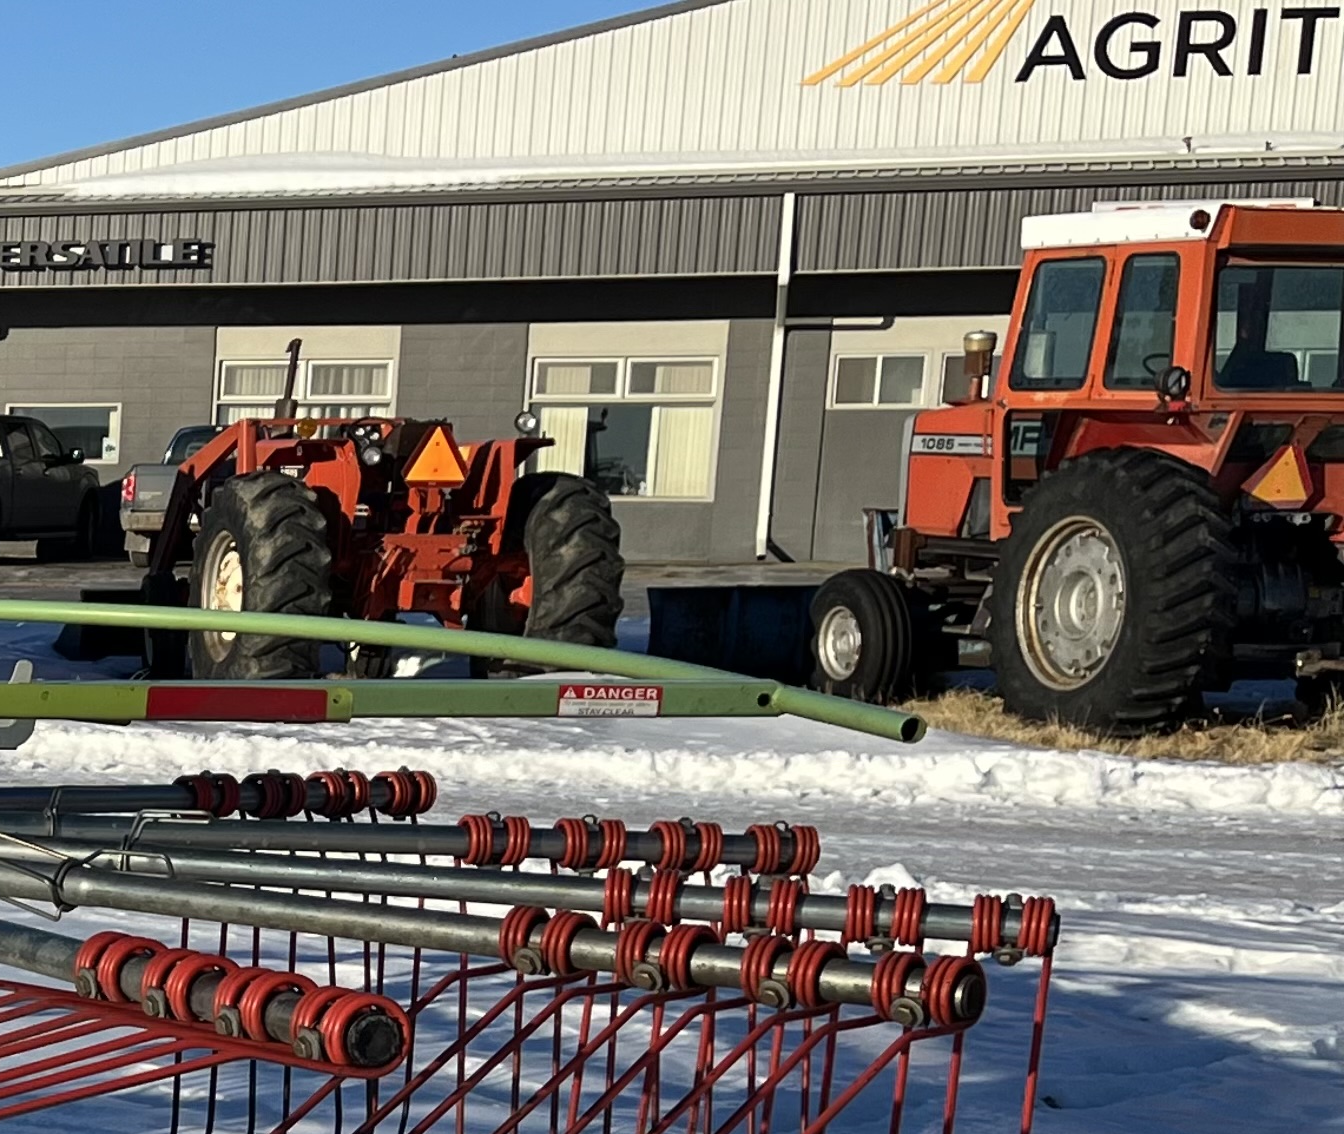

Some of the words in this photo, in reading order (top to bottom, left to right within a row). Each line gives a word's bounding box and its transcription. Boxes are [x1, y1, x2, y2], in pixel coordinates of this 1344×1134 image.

[1014, 7, 1340, 83] AGRIT
[921, 437, 955, 450] 1085
[583, 686, 658, 700] DANGER
[578, 707, 601, 716] STAY
[602, 707, 634, 716] CLEAR
